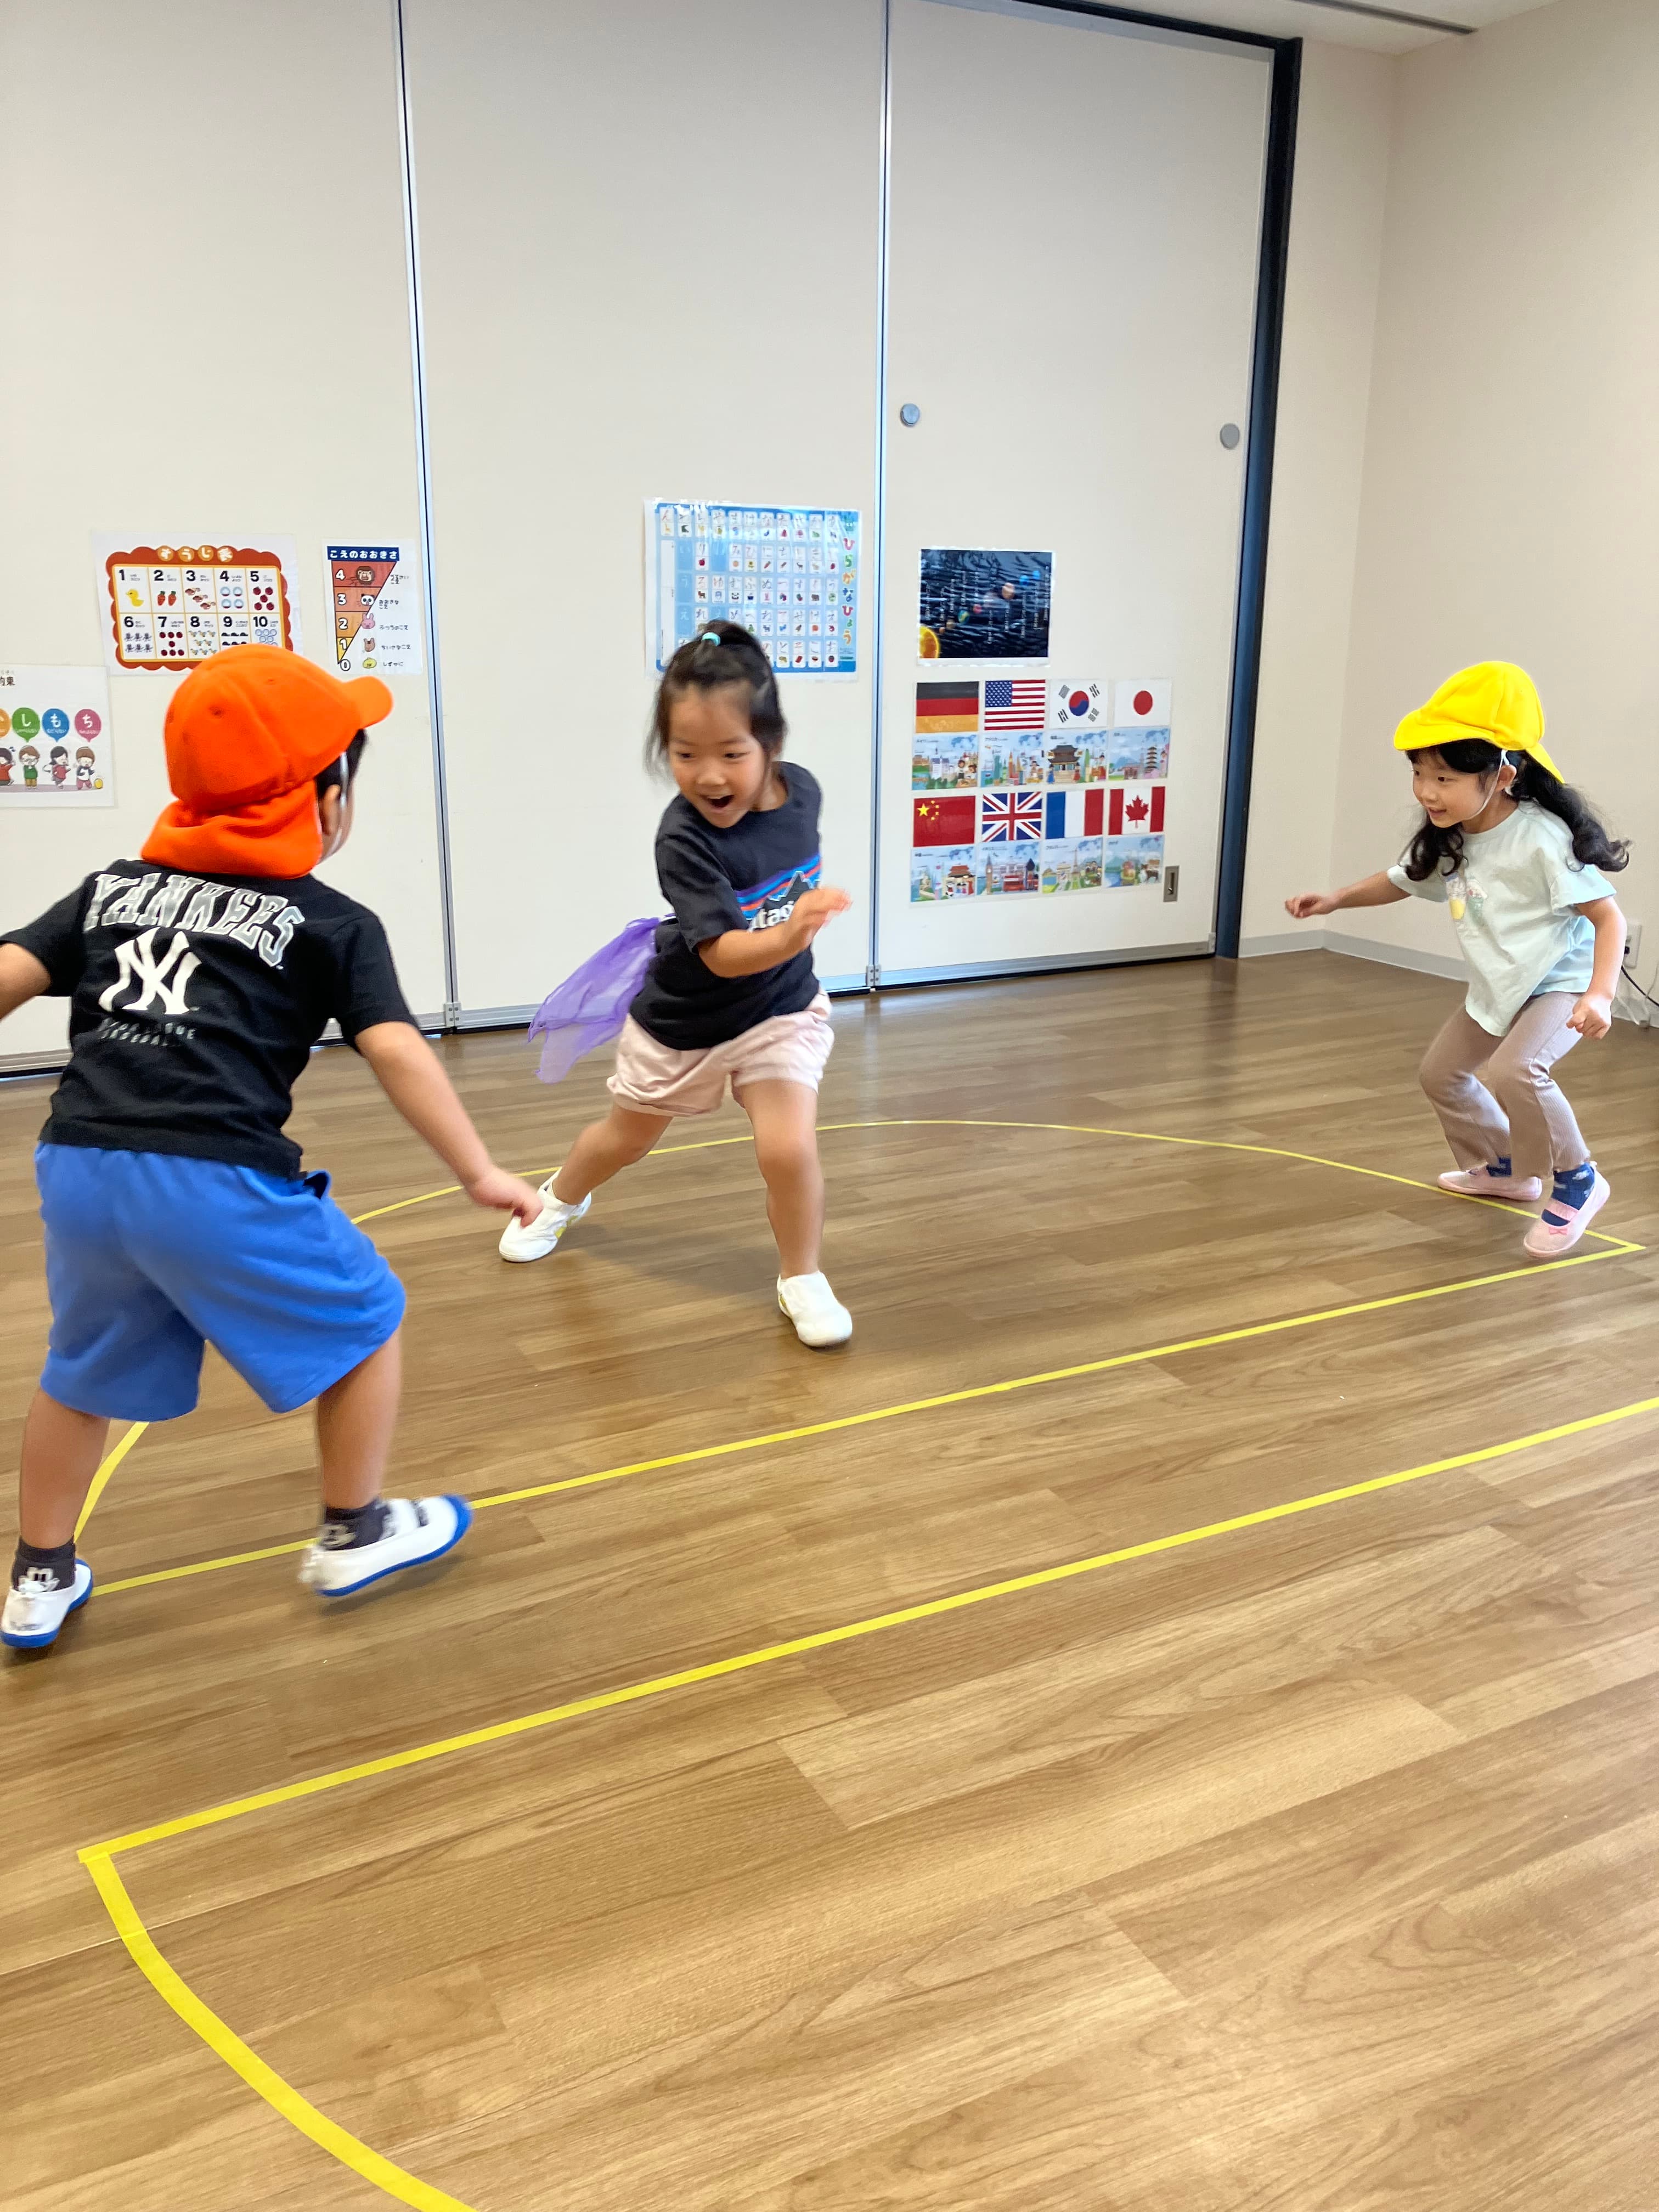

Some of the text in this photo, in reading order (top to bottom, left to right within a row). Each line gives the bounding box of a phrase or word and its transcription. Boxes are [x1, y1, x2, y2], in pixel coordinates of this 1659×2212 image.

[330, 550, 397, 560] こえのおおきさ
[119, 569, 125, 581] 1
[154, 569, 164, 581] 2
[186, 570, 195, 582] 3
[219, 571, 229, 582] 4
[250, 571, 259, 582] 5
[335, 569, 346, 581] 4
[337, 593, 347, 605] 3
[124, 616, 134, 628] 6
[157, 616, 167, 628] 7
[190, 616, 200, 628] 8
[223, 616, 233, 628] 9
[253, 616, 268, 627] 10
[338, 617, 348, 630] 2
[339, 638, 348, 650] 1
[340, 659, 351, 672] 0
[83, 872, 306, 967] YANKEES
[98, 927, 202, 1015] NY
